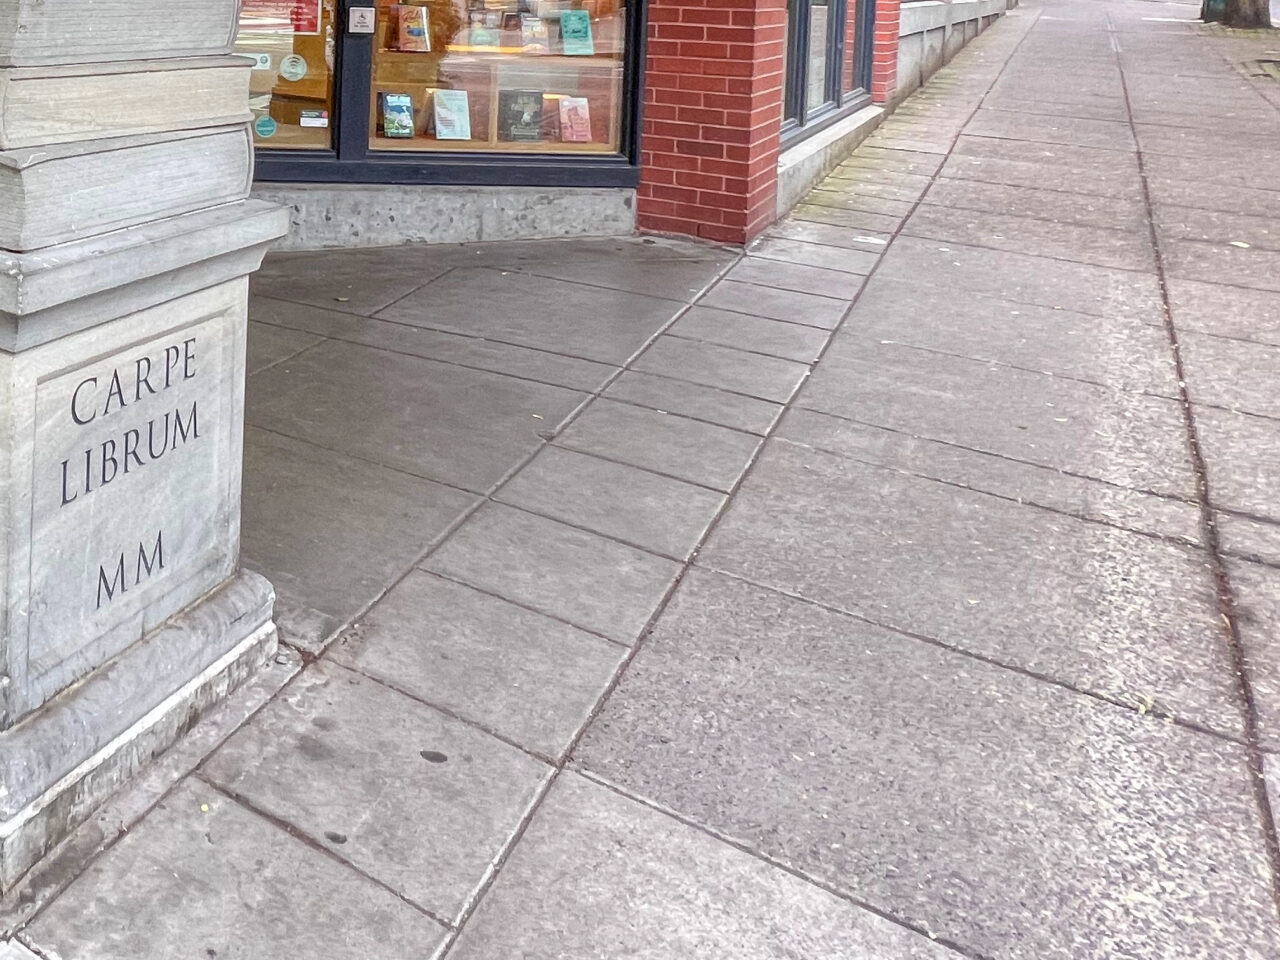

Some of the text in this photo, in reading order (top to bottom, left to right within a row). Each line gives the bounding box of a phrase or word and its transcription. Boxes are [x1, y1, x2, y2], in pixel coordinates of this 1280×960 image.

[70, 337, 197, 426] CARPE
[60, 400, 201, 508] LIBRUM
[96, 530, 165, 610] MM
